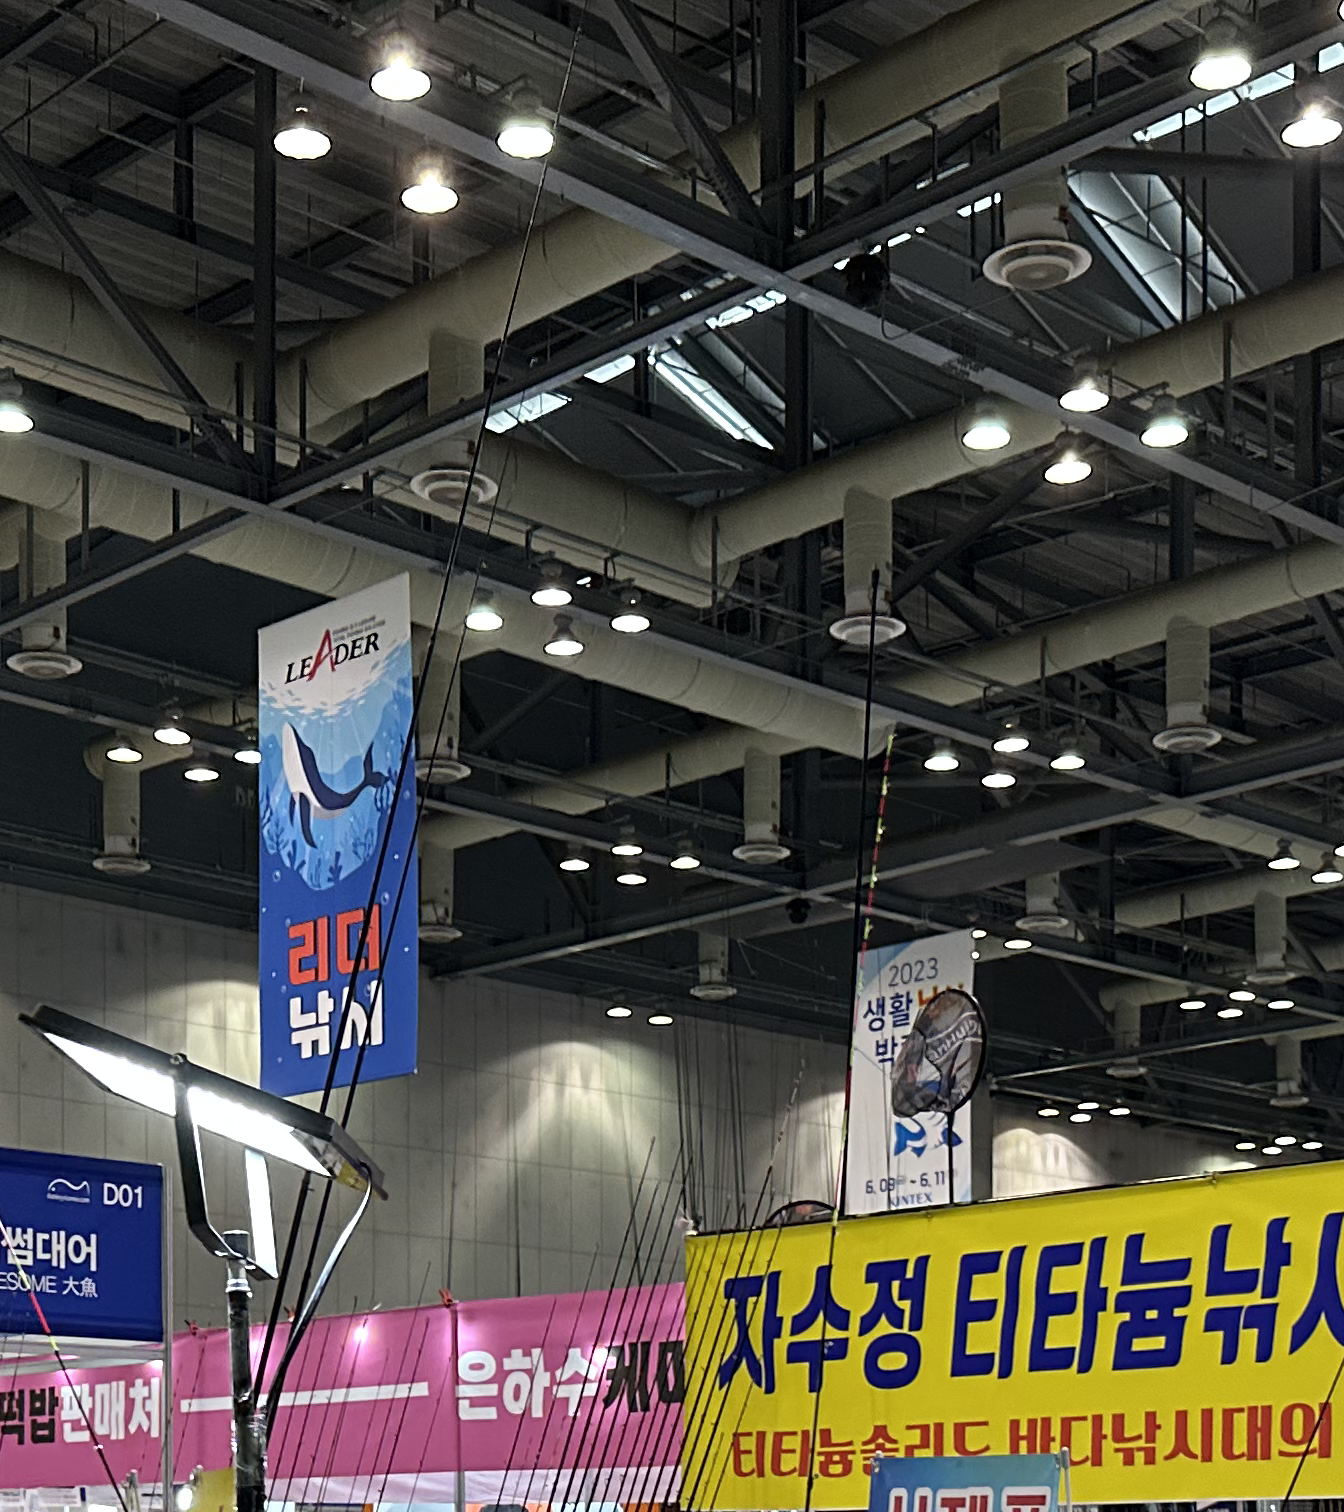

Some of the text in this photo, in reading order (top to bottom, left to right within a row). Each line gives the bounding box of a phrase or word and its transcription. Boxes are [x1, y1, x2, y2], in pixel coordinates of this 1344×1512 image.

[284, 629, 381, 685] LEADER
[288, 903, 381, 985] 리더
[887, 957, 939, 989] 2023
[289, 979, 384, 1059] 낚시
[102, 1182, 144, 1210] D01
[62, 1276, 99, 1299] 大魚
[718, 1253, 932, 1396] 자수정
[1009, 1401, 1333, 1470] 바다낚시대의
